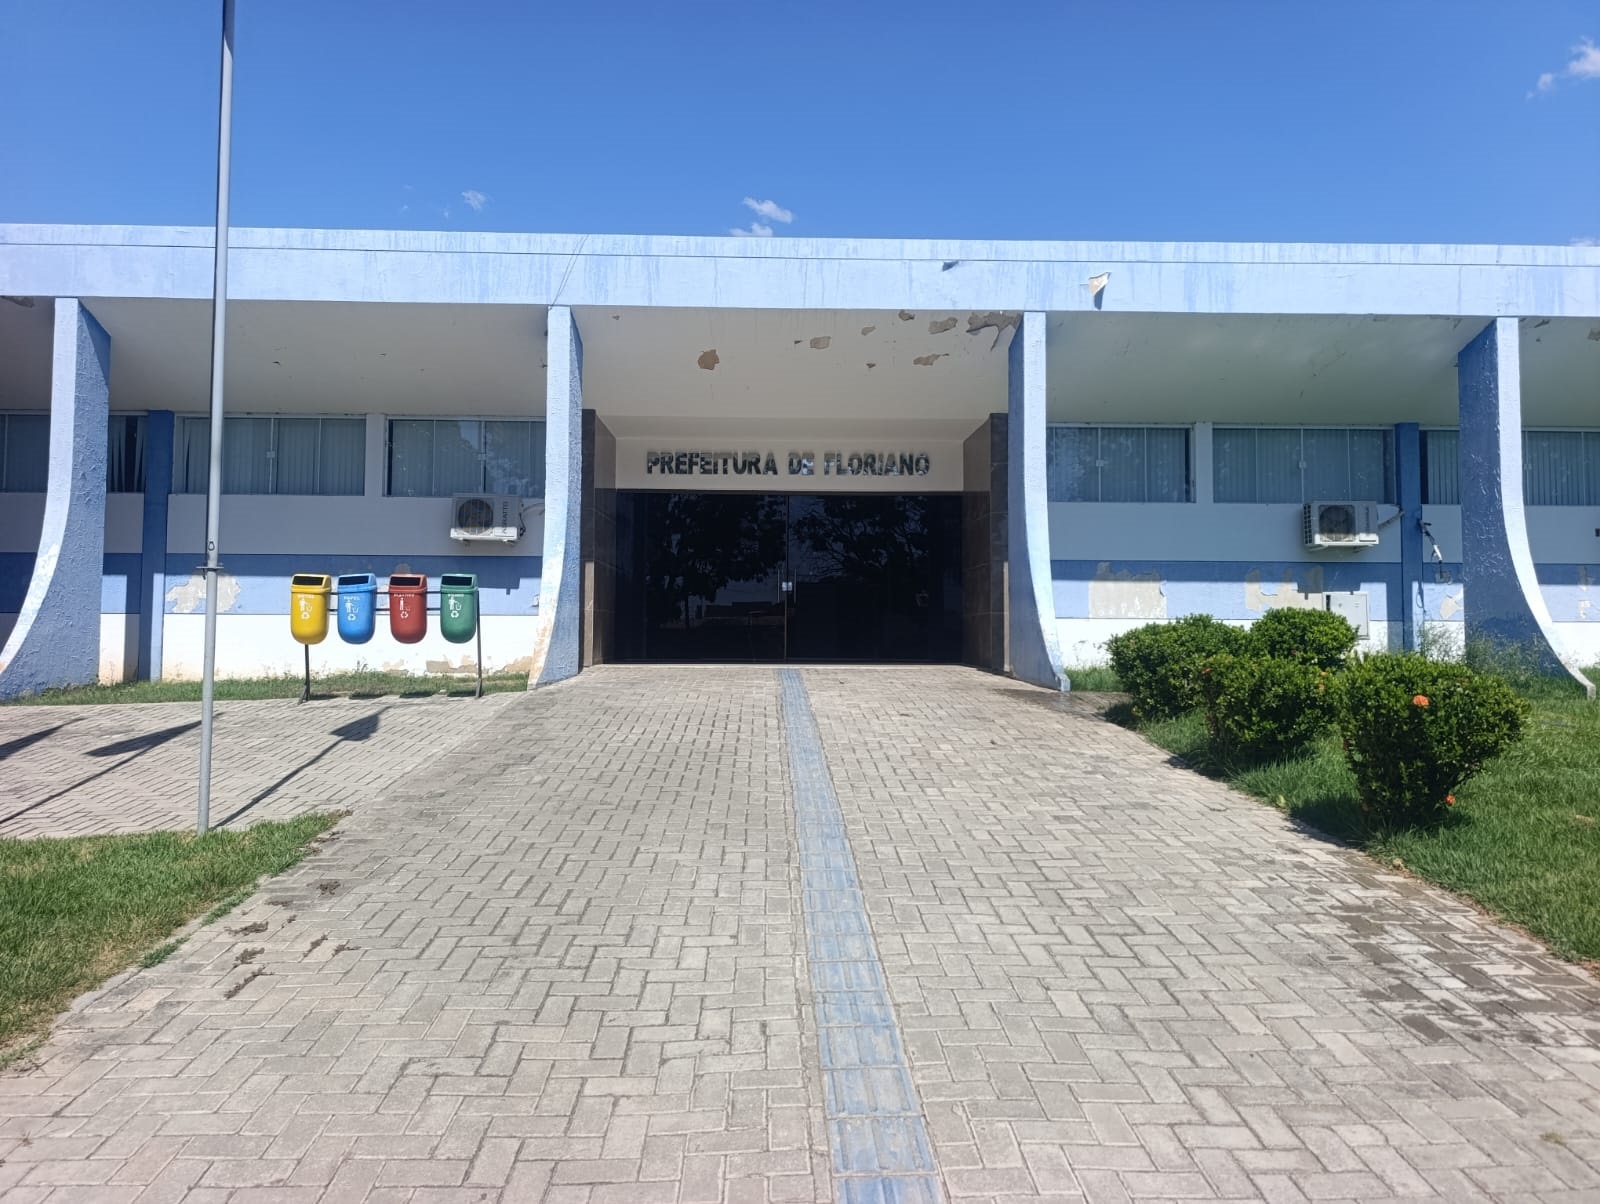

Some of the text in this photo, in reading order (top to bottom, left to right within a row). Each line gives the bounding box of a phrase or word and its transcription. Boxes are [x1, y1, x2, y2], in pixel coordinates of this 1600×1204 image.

[647, 451, 930, 476] PREFEITURA DE FLORIANO
